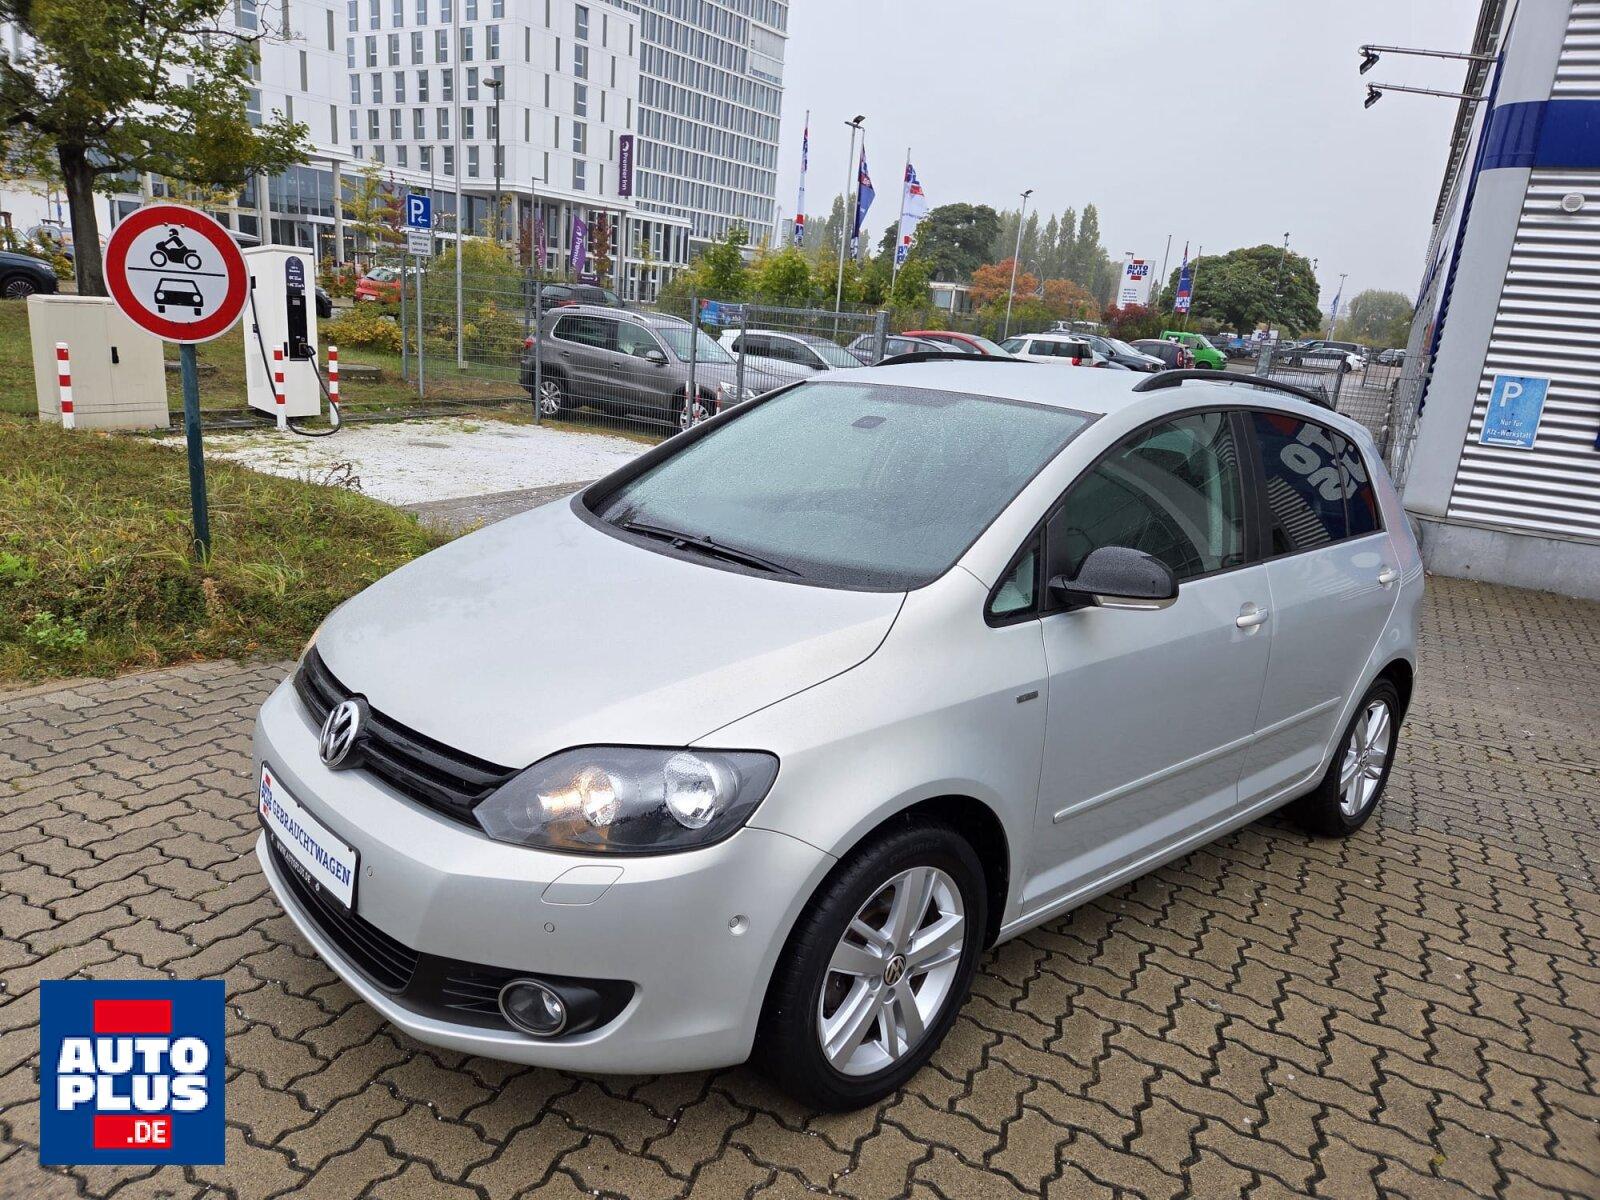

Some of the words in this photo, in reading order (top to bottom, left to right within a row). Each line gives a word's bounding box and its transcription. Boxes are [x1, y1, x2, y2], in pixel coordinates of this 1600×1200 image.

[411, 199, 424, 223] P
[1500, 382, 1523, 407] P
[1486, 428, 1532, 439] Kfz-Werkstatt
[1500, 418, 1511, 426] Nur
[272, 800, 352, 887] GEBRAUCHTWAGEN
